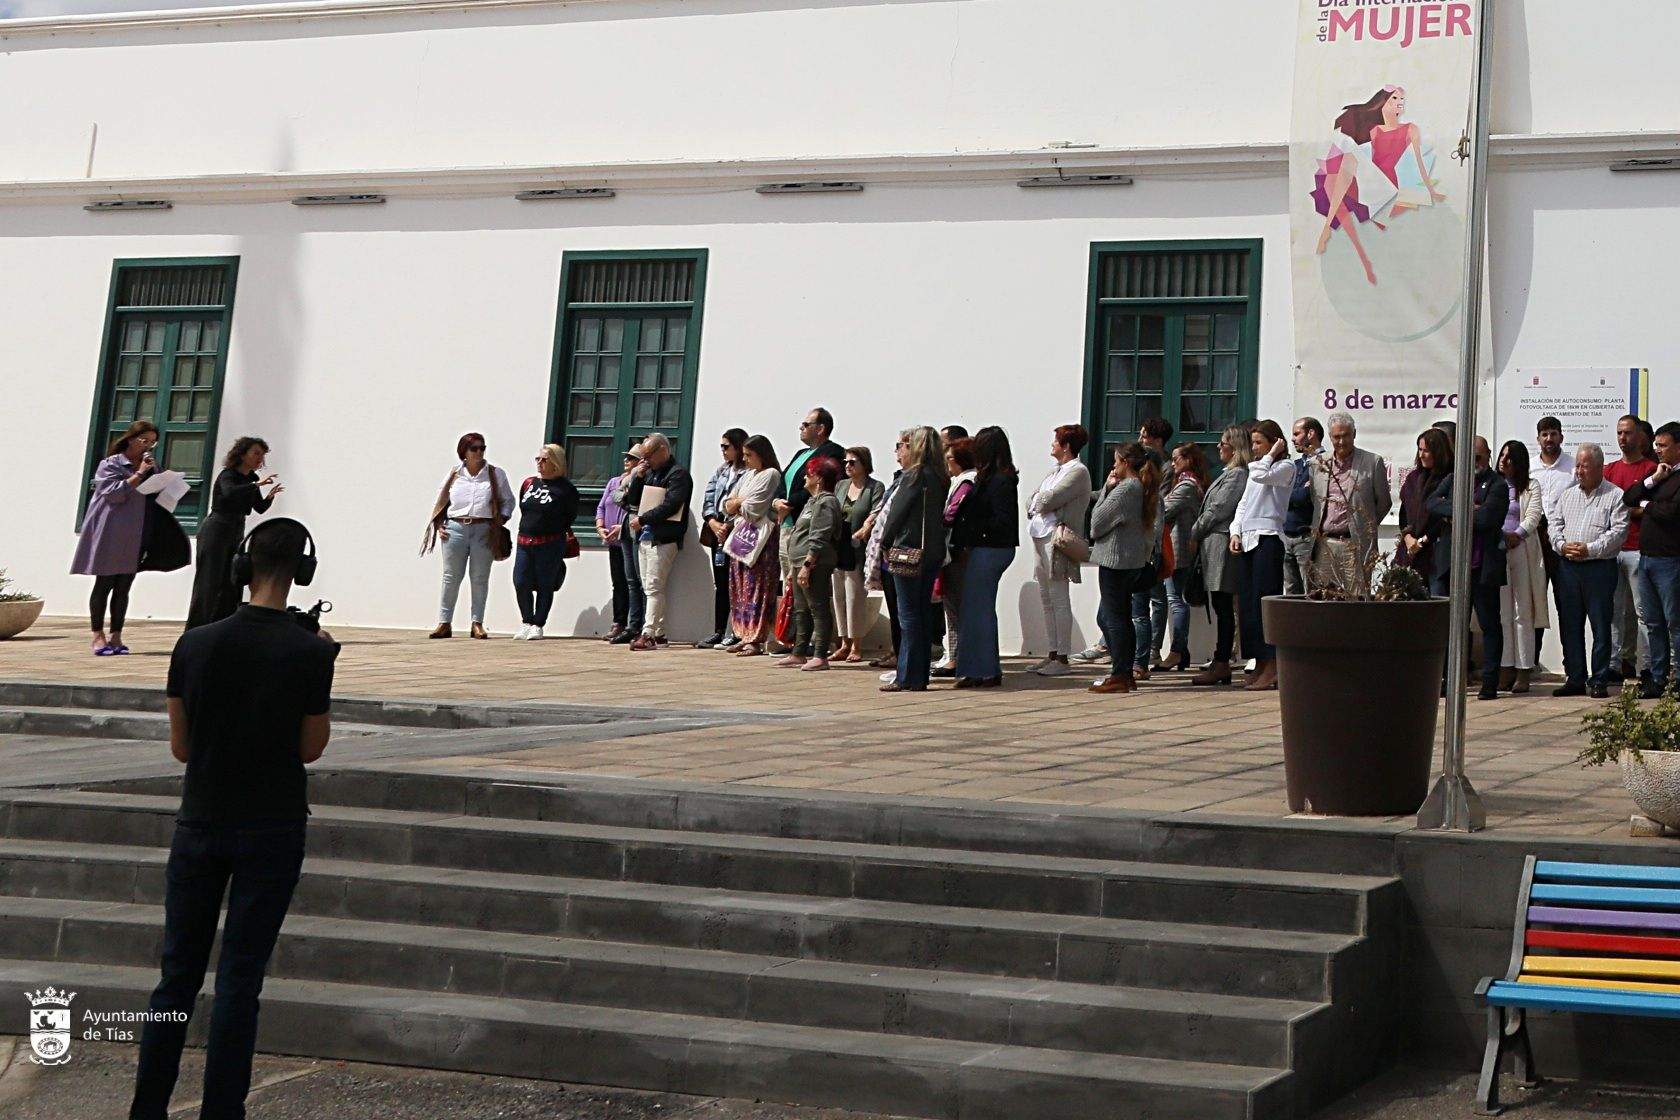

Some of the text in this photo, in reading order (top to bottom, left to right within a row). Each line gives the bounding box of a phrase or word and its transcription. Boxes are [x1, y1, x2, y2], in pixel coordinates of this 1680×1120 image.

[1316, 10, 1328, 42] de la
[1327, 3, 1472, 48] MUJER
[1324, 388, 1337, 410] 8
[1345, 388, 1374, 410] de
